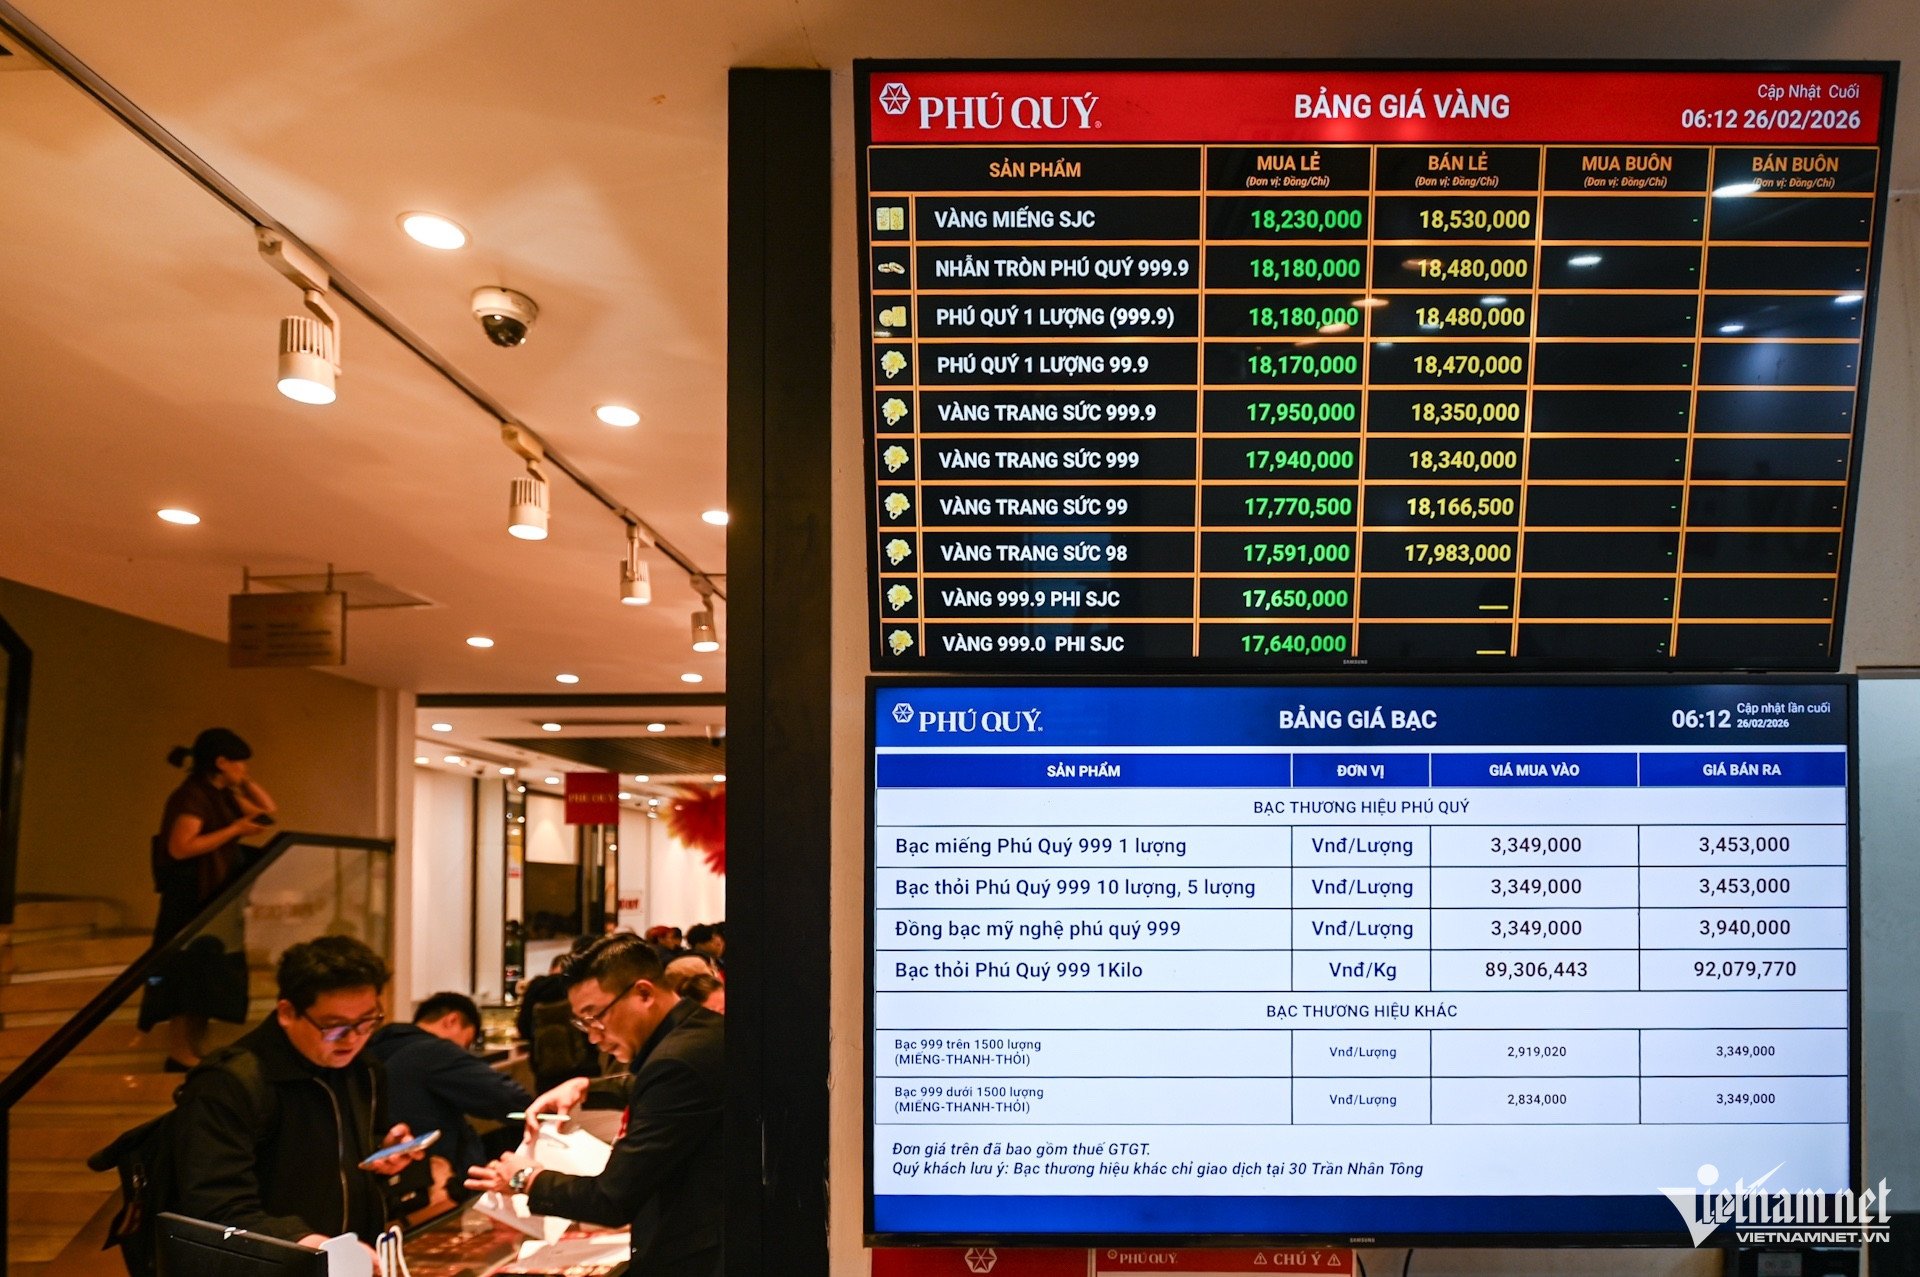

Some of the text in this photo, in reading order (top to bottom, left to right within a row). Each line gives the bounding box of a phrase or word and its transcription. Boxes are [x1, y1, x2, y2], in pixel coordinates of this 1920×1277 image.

[1758, 83, 1859, 101] Cập Nhật Cuối
[919, 92, 1004, 129] PHÚ
[1295, 86, 1509, 118] BẢNG GIÁ VÀNG
[1682, 109, 1860, 130] 06:12 26/02/2026
[990, 158, 1080, 177] SẢN PHẨM
[1258, 151, 1320, 170] MUA LẺ
[1429, 151, 1488, 170] BÁN LẺ
[1582, 153, 1672, 171] MUA BUÔN
[1752, 153, 1838, 172] BÁN BUÔN
[934, 206, 1095, 228] VÀNG MIẾNG SJC
[1252, 210, 1361, 232] 18,230,000
[1420, 210, 1530, 232] 18,530,000
[936, 255, 1189, 278] NHẪN TRÒN PHÚ QUÝ 999.9
[1251, 259, 1360, 281] 18,180,000
[1418, 259, 1527, 281] 18,480,000
[938, 400, 1156, 421] VÀNG TRANG SỨC 999.9
[1247, 403, 1355, 424] 17,950,000
[1412, 403, 1519, 424] 18,350,000
[941, 541, 1127, 561] VÀNG TRANG SỨC 98
[1244, 544, 1349, 565] 17,591,000
[1405, 544, 1511, 565] 17,983,000
[1280, 705, 1437, 731] BẢNG GIÁ BẠC
[1737, 702, 1830, 715] Cập nhật lần cuối
[919, 709, 977, 732] PHÚ
[1672, 710, 1731, 728] 06:12
[1737, 719, 1789, 728] 26/02/2026
[1047, 761, 1120, 777] SẢN PHẨM
[1337, 764, 1384, 780] ĐƠN VỊ
[1489, 762, 1579, 776] GIÁ MUA VÀO
[1703, 762, 1781, 776] GIÁ BÁN RA
[1254, 798, 1469, 816] BẠC THƯƠNG HIỆU PHÚ QUÝ
[897, 837, 1185, 857] Bạc miếng Phú Quý 999 1 lượng
[1312, 838, 1412, 856] Vnđ/Lượng
[1491, 838, 1581, 855] 3,349,000
[1700, 837, 1789, 855] 3,453,000
[895, 920, 1180, 940] Đồng bạc mỹ nghệ phú quý 999
[1312, 920, 1412, 939] Vnđ/Lượng
[1492, 921, 1581, 938] 3,349,000
[1700, 920, 1790, 938] 3,940,000
[896, 961, 1142, 981] Bạc thỏi Phú Quý 999 1Kilo
[1329, 962, 1396, 981] Vnđ/Kg
[1486, 962, 1587, 980] 89,306,443
[1694, 961, 1796, 979] 92,079,770
[1267, 1002, 1457, 1020] BẠC THƯƠNG HIỆU KHÁC
[895, 1039, 1041, 1052] Bạc 999 trên 1500 lượng
[1330, 1047, 1396, 1059] Vnđ/Lượng
[1508, 1047, 1566, 1058] 2,919,020
[1717, 1046, 1775, 1057] 3,349,000
[893, 1142, 1149, 1158] Đơn giá trên đã bao gồm thuế GTGT.
[893, 1161, 1423, 1177] Quý khách lưu ý: Bạc thương hiệu khác chỉ giao dịch tại 30 Trần Nhân Tông
